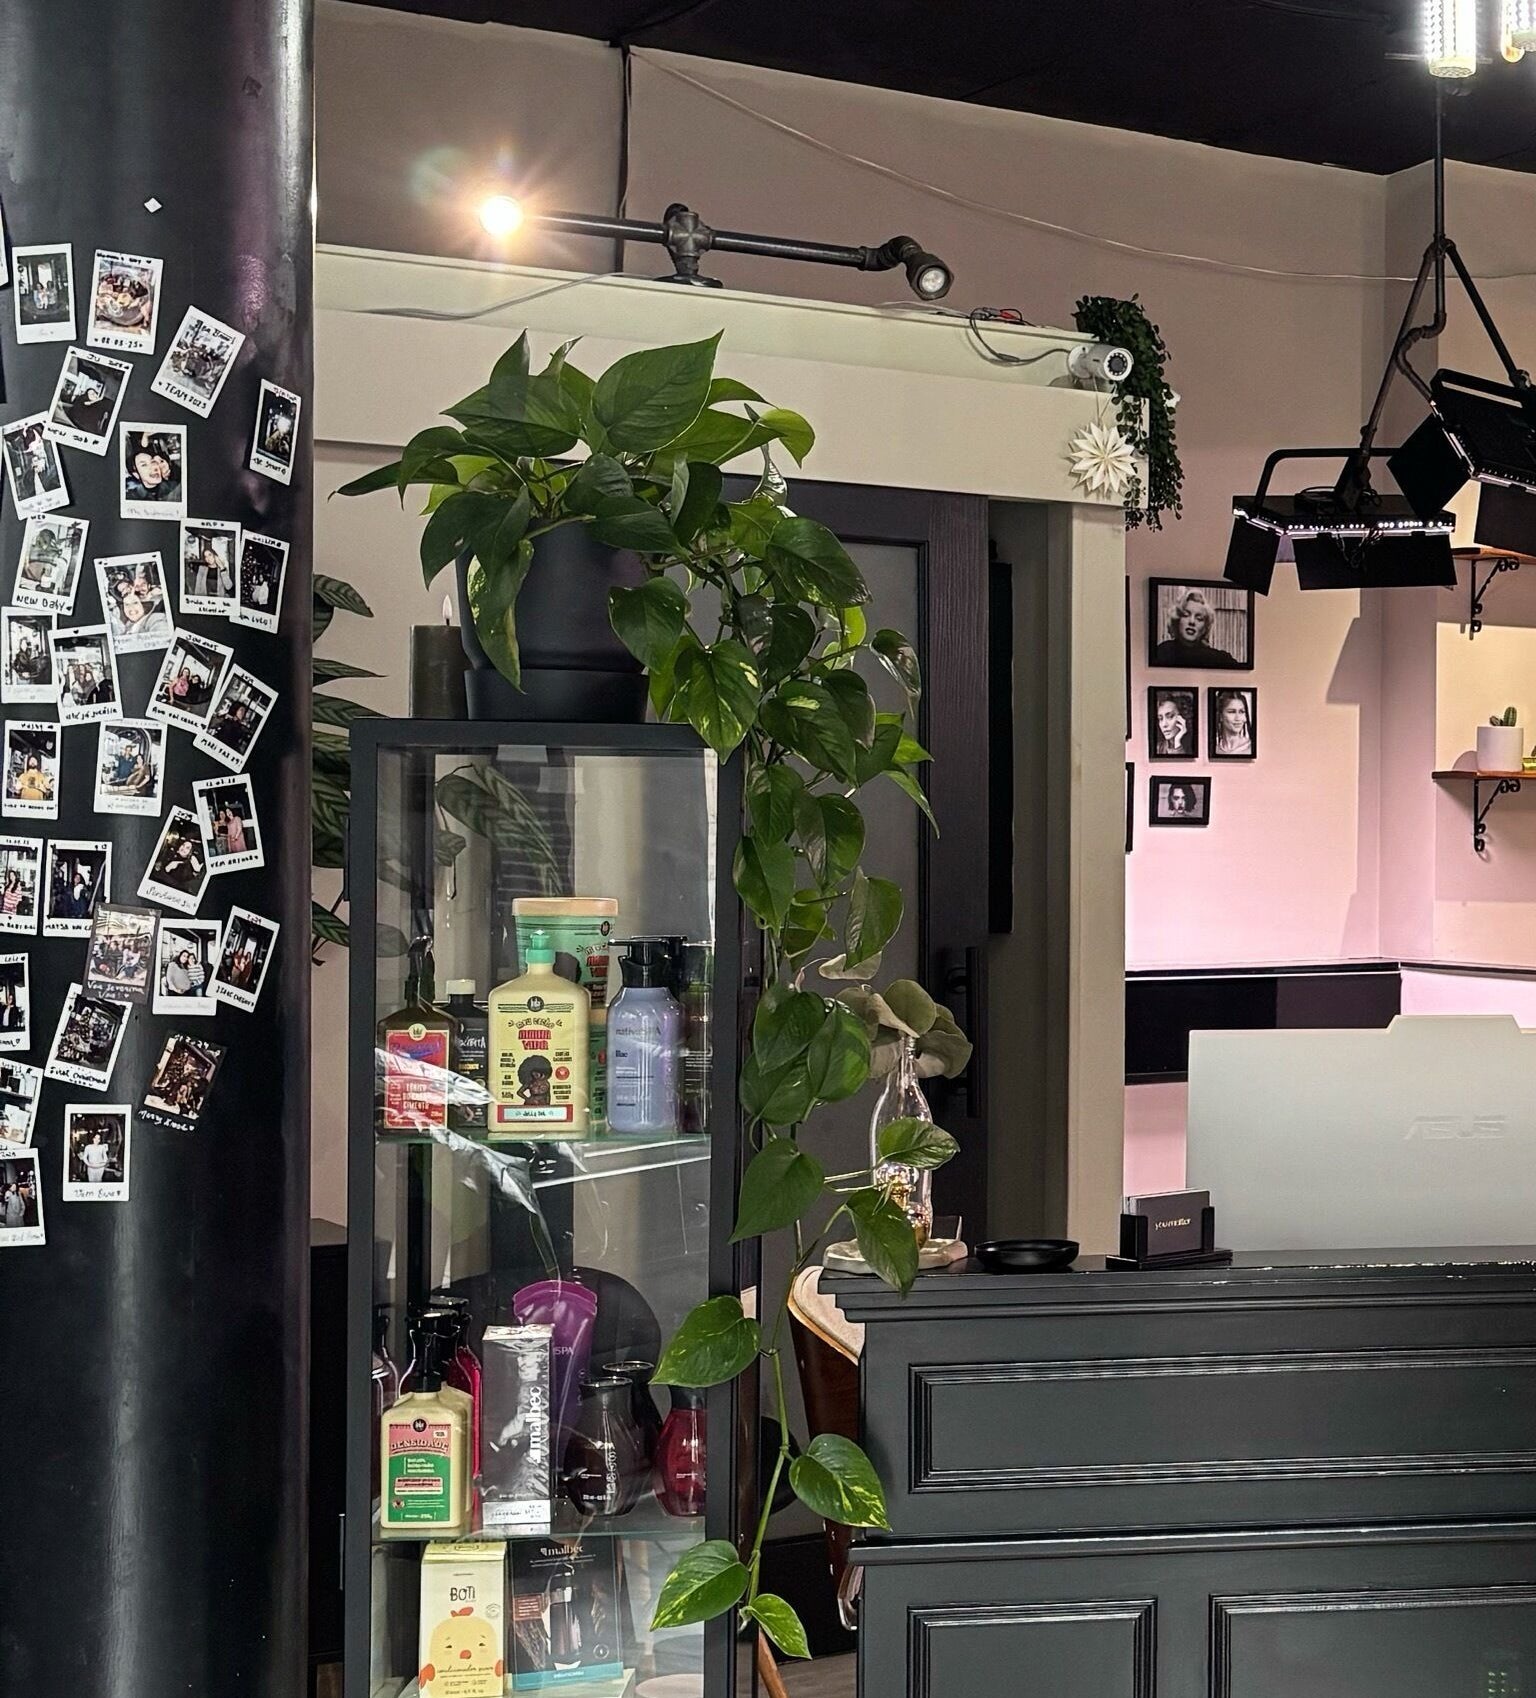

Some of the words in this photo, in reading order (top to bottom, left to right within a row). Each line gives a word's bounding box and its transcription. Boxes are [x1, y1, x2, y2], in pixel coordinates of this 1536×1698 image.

[1403, 1115, 1506, 1140] ASUS
[525, 1386, 542, 1448] malbec
[390, 1439, 449, 1451] DENSIDADE
[547, 1544, 584, 1557] malbec
[450, 1586, 476, 1602] BOTI
